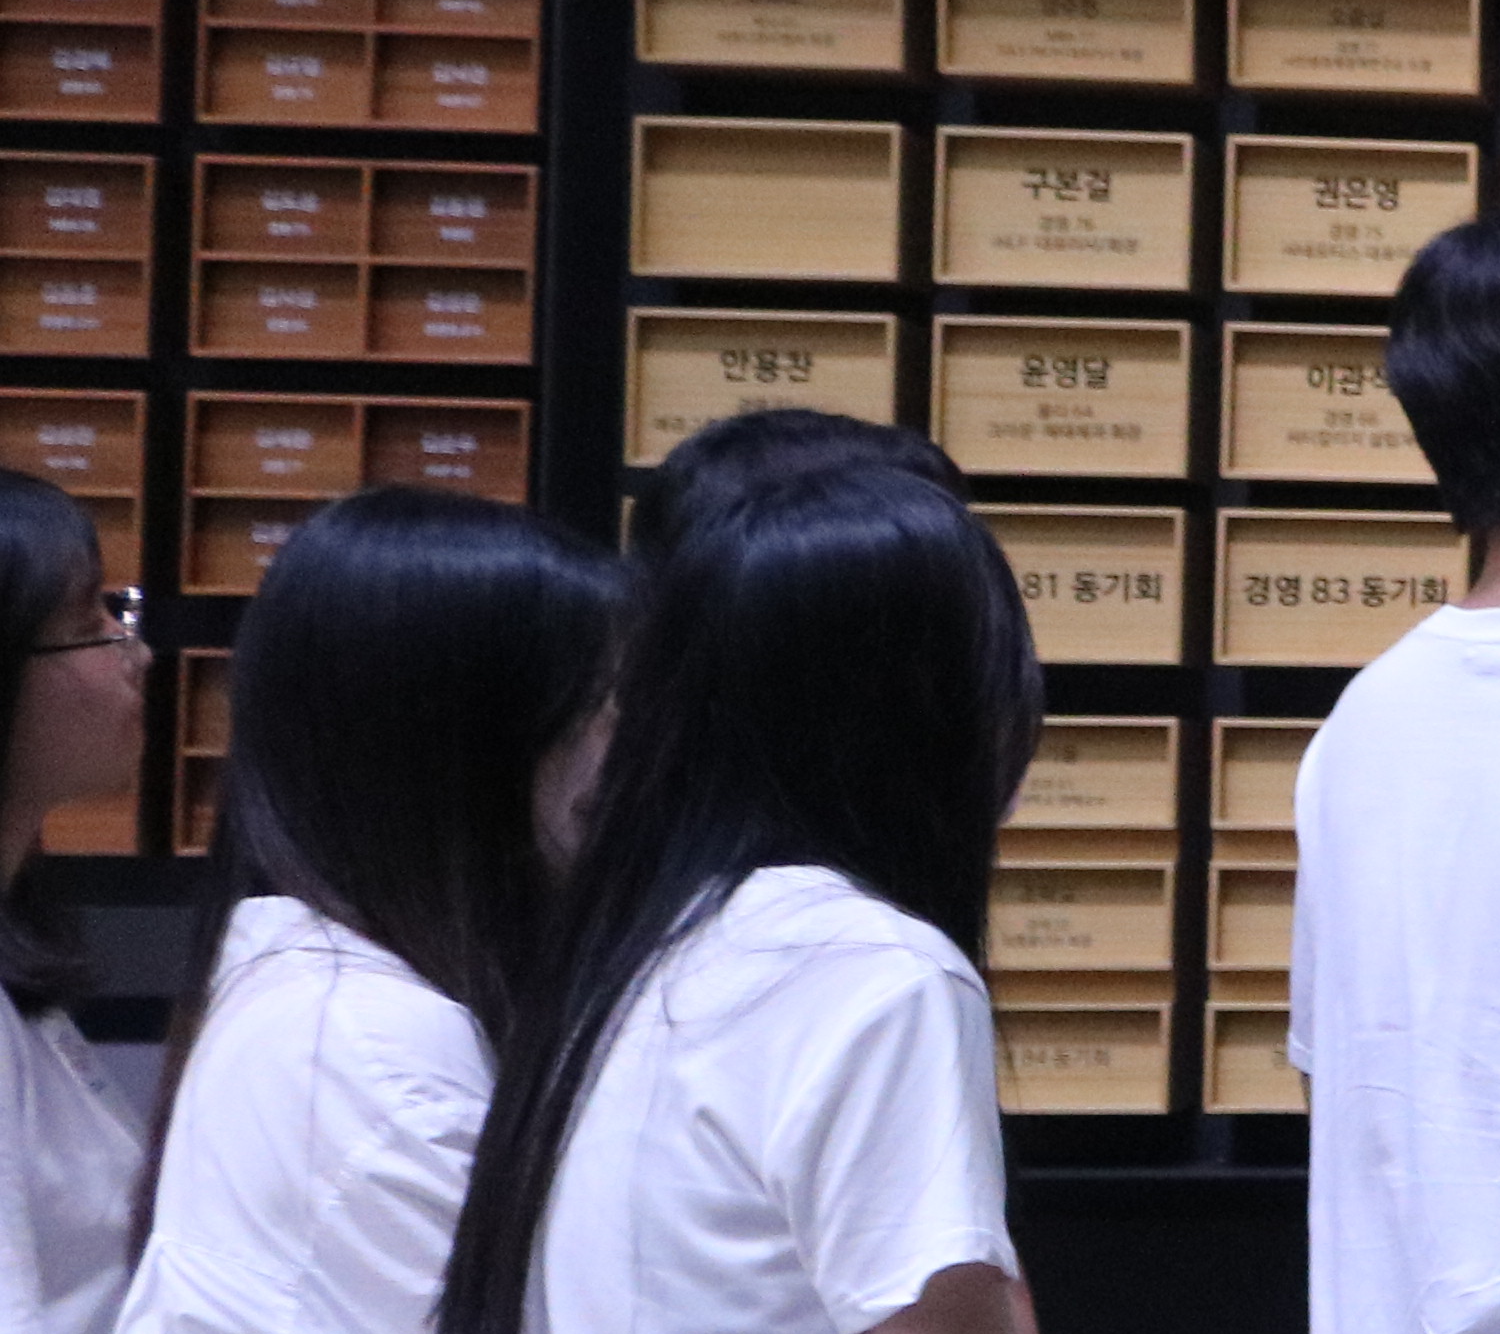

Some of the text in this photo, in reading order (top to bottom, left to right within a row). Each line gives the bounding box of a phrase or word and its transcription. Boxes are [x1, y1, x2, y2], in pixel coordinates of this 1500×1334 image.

[1021, 166, 1111, 203] 구본걸
[1314, 176, 1400, 211] 권은영
[1019, 353, 1111, 390] 윤영달
[1022, 570, 1164, 605] 81 동기회
[1242, 574, 1449, 609] 경영 83 동기회
